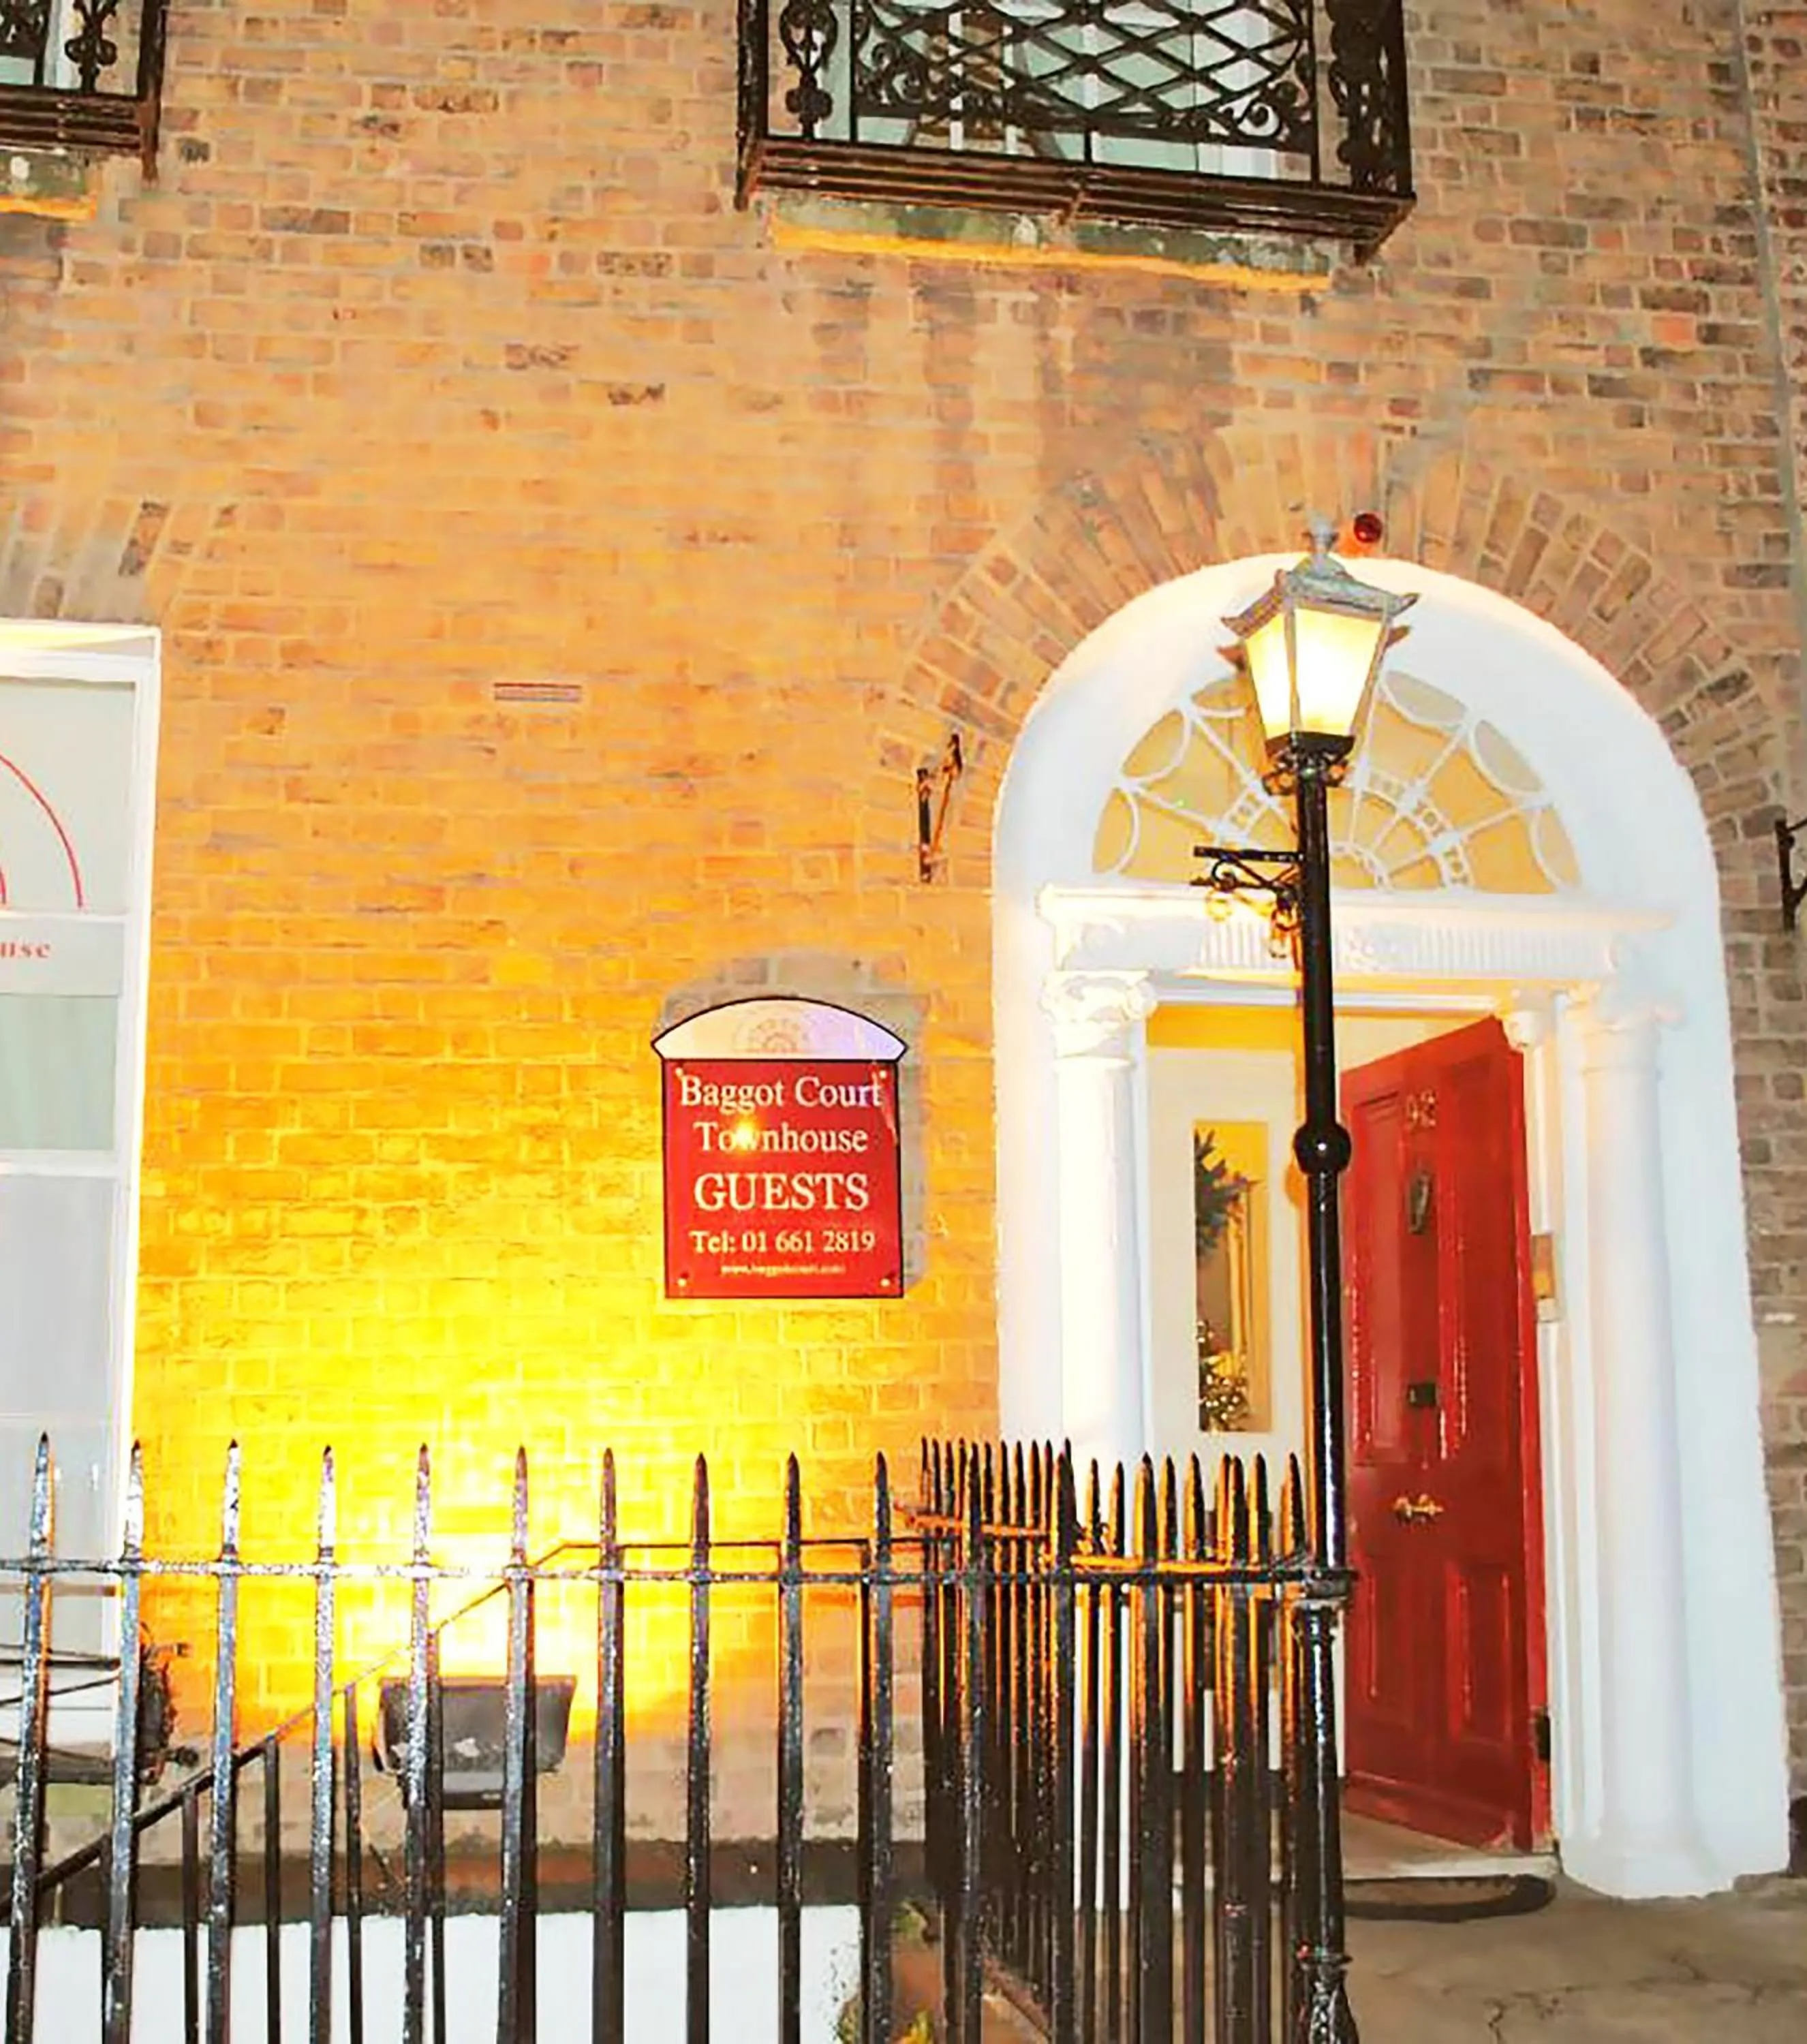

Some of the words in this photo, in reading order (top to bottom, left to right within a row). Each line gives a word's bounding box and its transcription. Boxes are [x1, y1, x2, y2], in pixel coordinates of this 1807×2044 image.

[681, 1074, 784, 1115] Baggot
[794, 1076, 884, 1108] Court
[694, 1172, 869, 1212] GUESTS
[688, 1230, 736, 1254] Tel:
[741, 1230, 768, 1253] 01
[775, 1230, 814, 1253] 661
[822, 1230, 876, 1253] 2819
